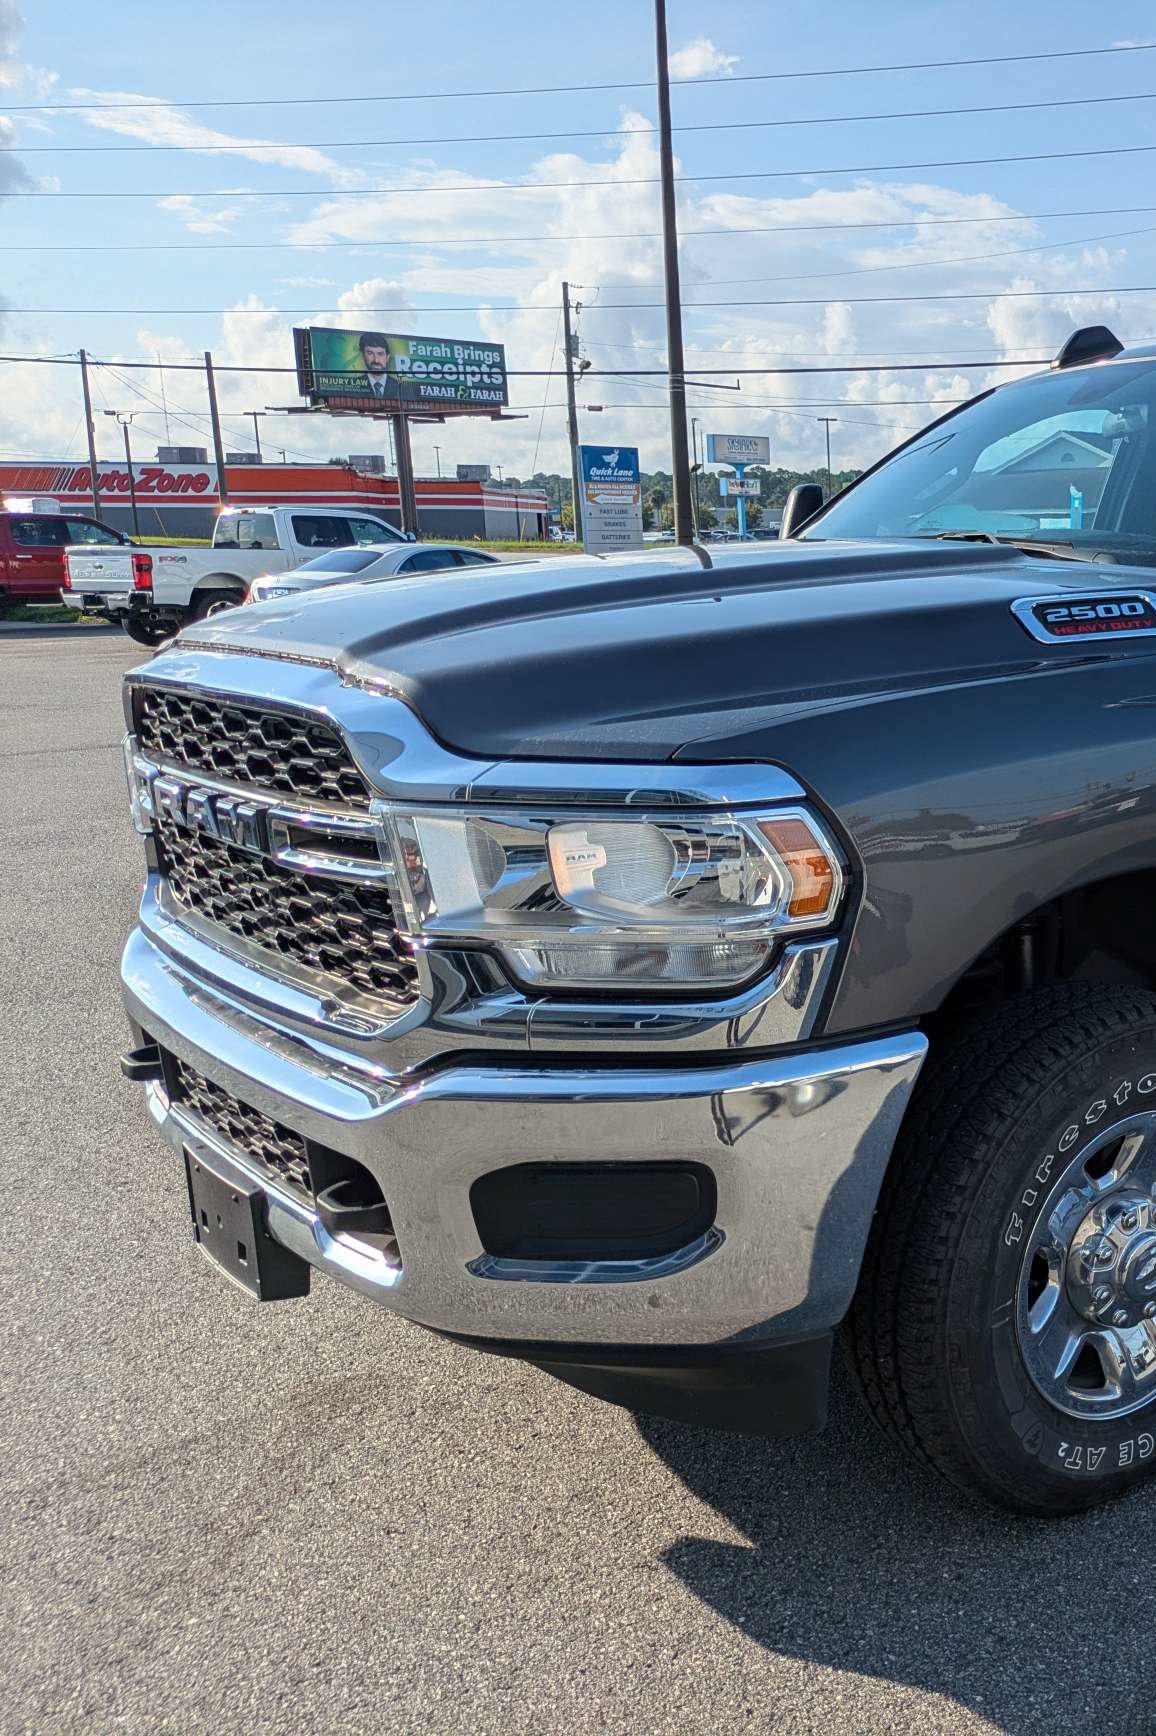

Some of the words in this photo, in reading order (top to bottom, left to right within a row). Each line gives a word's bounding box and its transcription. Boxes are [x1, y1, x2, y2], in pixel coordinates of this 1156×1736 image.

[408, 341, 450, 357] Farah
[453, 344, 501, 365] Brings
[394, 356, 504, 386] Receipts
[319, 376, 350, 386] INJURY
[351, 379, 368, 387] LAW
[420, 385, 456, 398] FARAH
[470, 388, 504, 401] FARAH
[67, 467, 211, 493] AutoZone
[589, 467, 613, 476] Quick
[613, 467, 634, 476] Lane
[158, 555, 188, 564] FX4
[1044, 602, 1145, 622] 2500
[1055, 622, 1109, 635] HEAVY
[1110, 618, 1153, 630] DUTY
[153, 777, 261, 850] RAM
